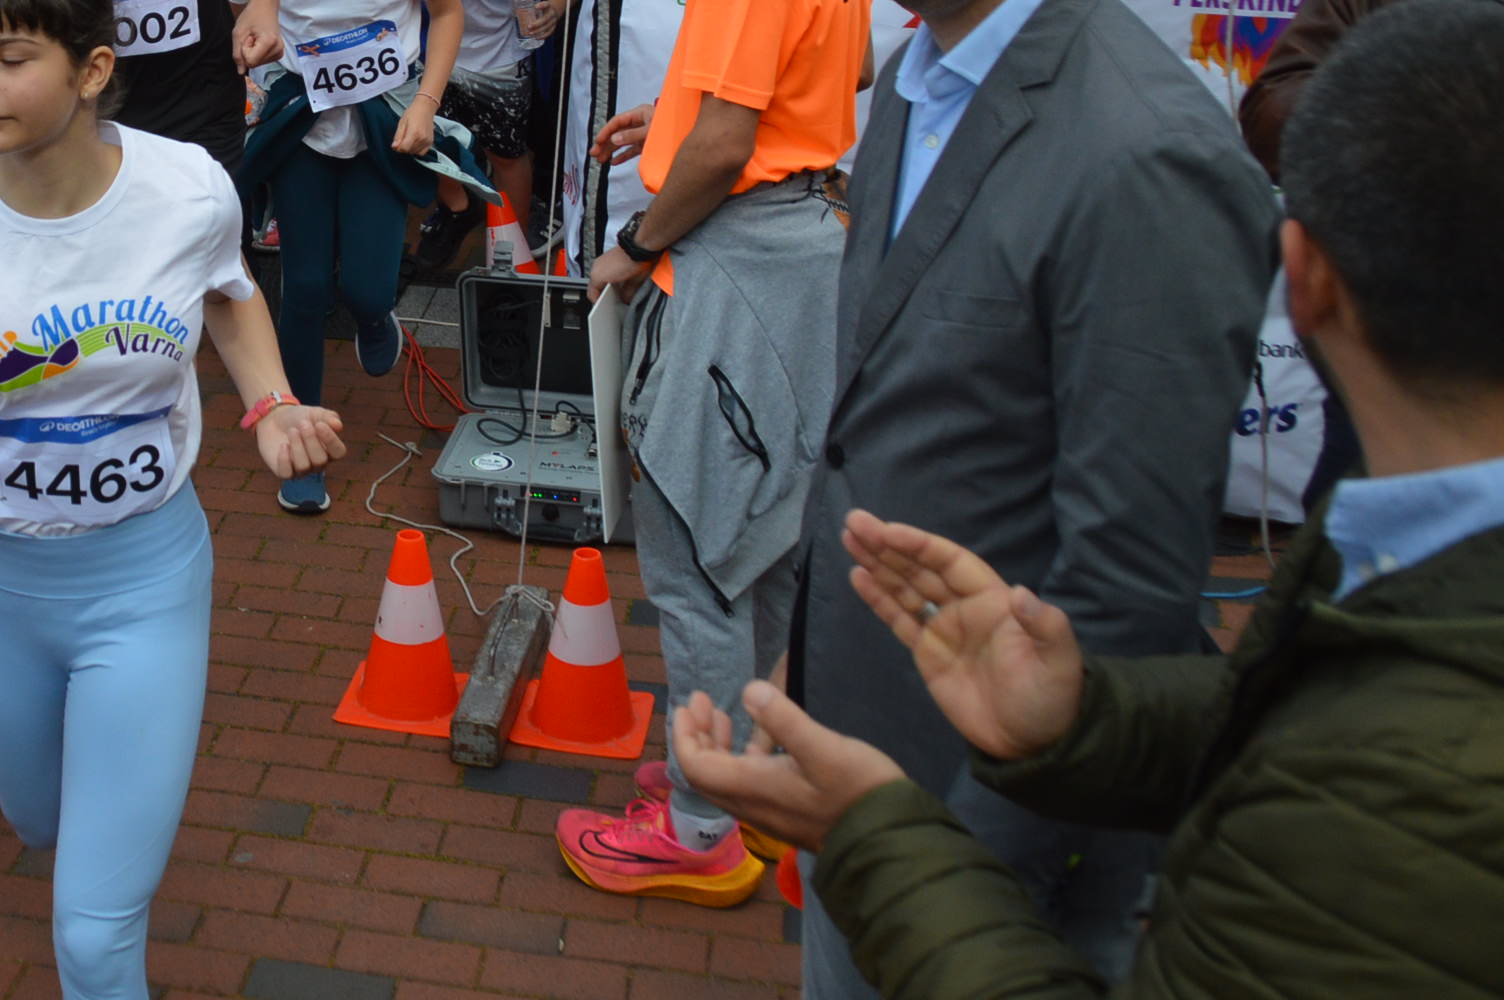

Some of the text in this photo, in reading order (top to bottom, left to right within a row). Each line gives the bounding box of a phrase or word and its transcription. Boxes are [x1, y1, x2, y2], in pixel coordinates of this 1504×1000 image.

[331, 28, 368, 45] DECATHLON
[313, 48, 399, 93] 4636
[32, 295, 189, 353] Marathon
[105, 325, 184, 363] Varna
[4, 445, 165, 505] 4463
